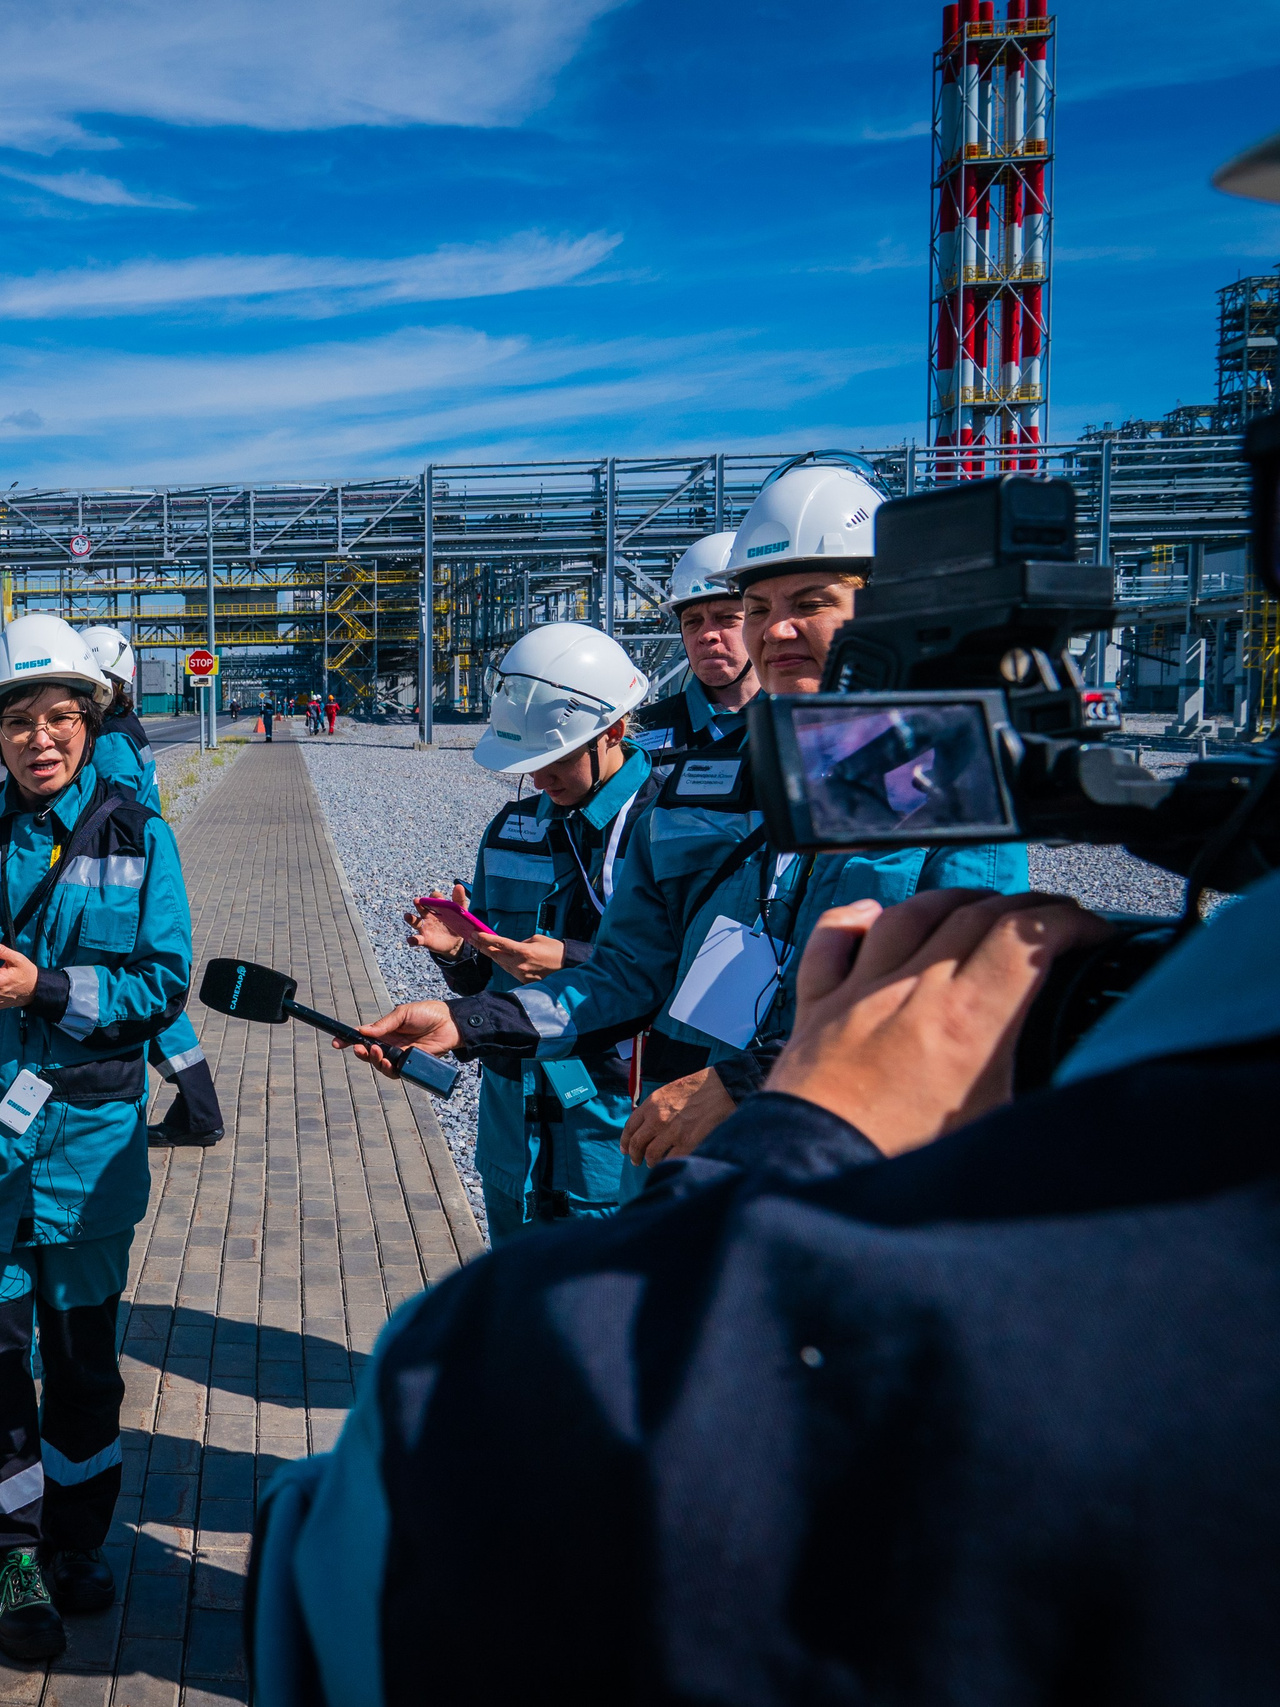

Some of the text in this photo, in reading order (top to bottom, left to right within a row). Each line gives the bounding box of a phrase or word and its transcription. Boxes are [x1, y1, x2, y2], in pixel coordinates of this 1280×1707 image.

[747, 541, 789, 558] СИБУР
[15, 658, 51, 670] СИБУР
[190, 659, 213, 667] STOP
[496, 730, 522, 741] СИБУР
[230, 969, 247, 1010] САЛЕХАРД
[7, 1099, 31, 1116] СИБУР
